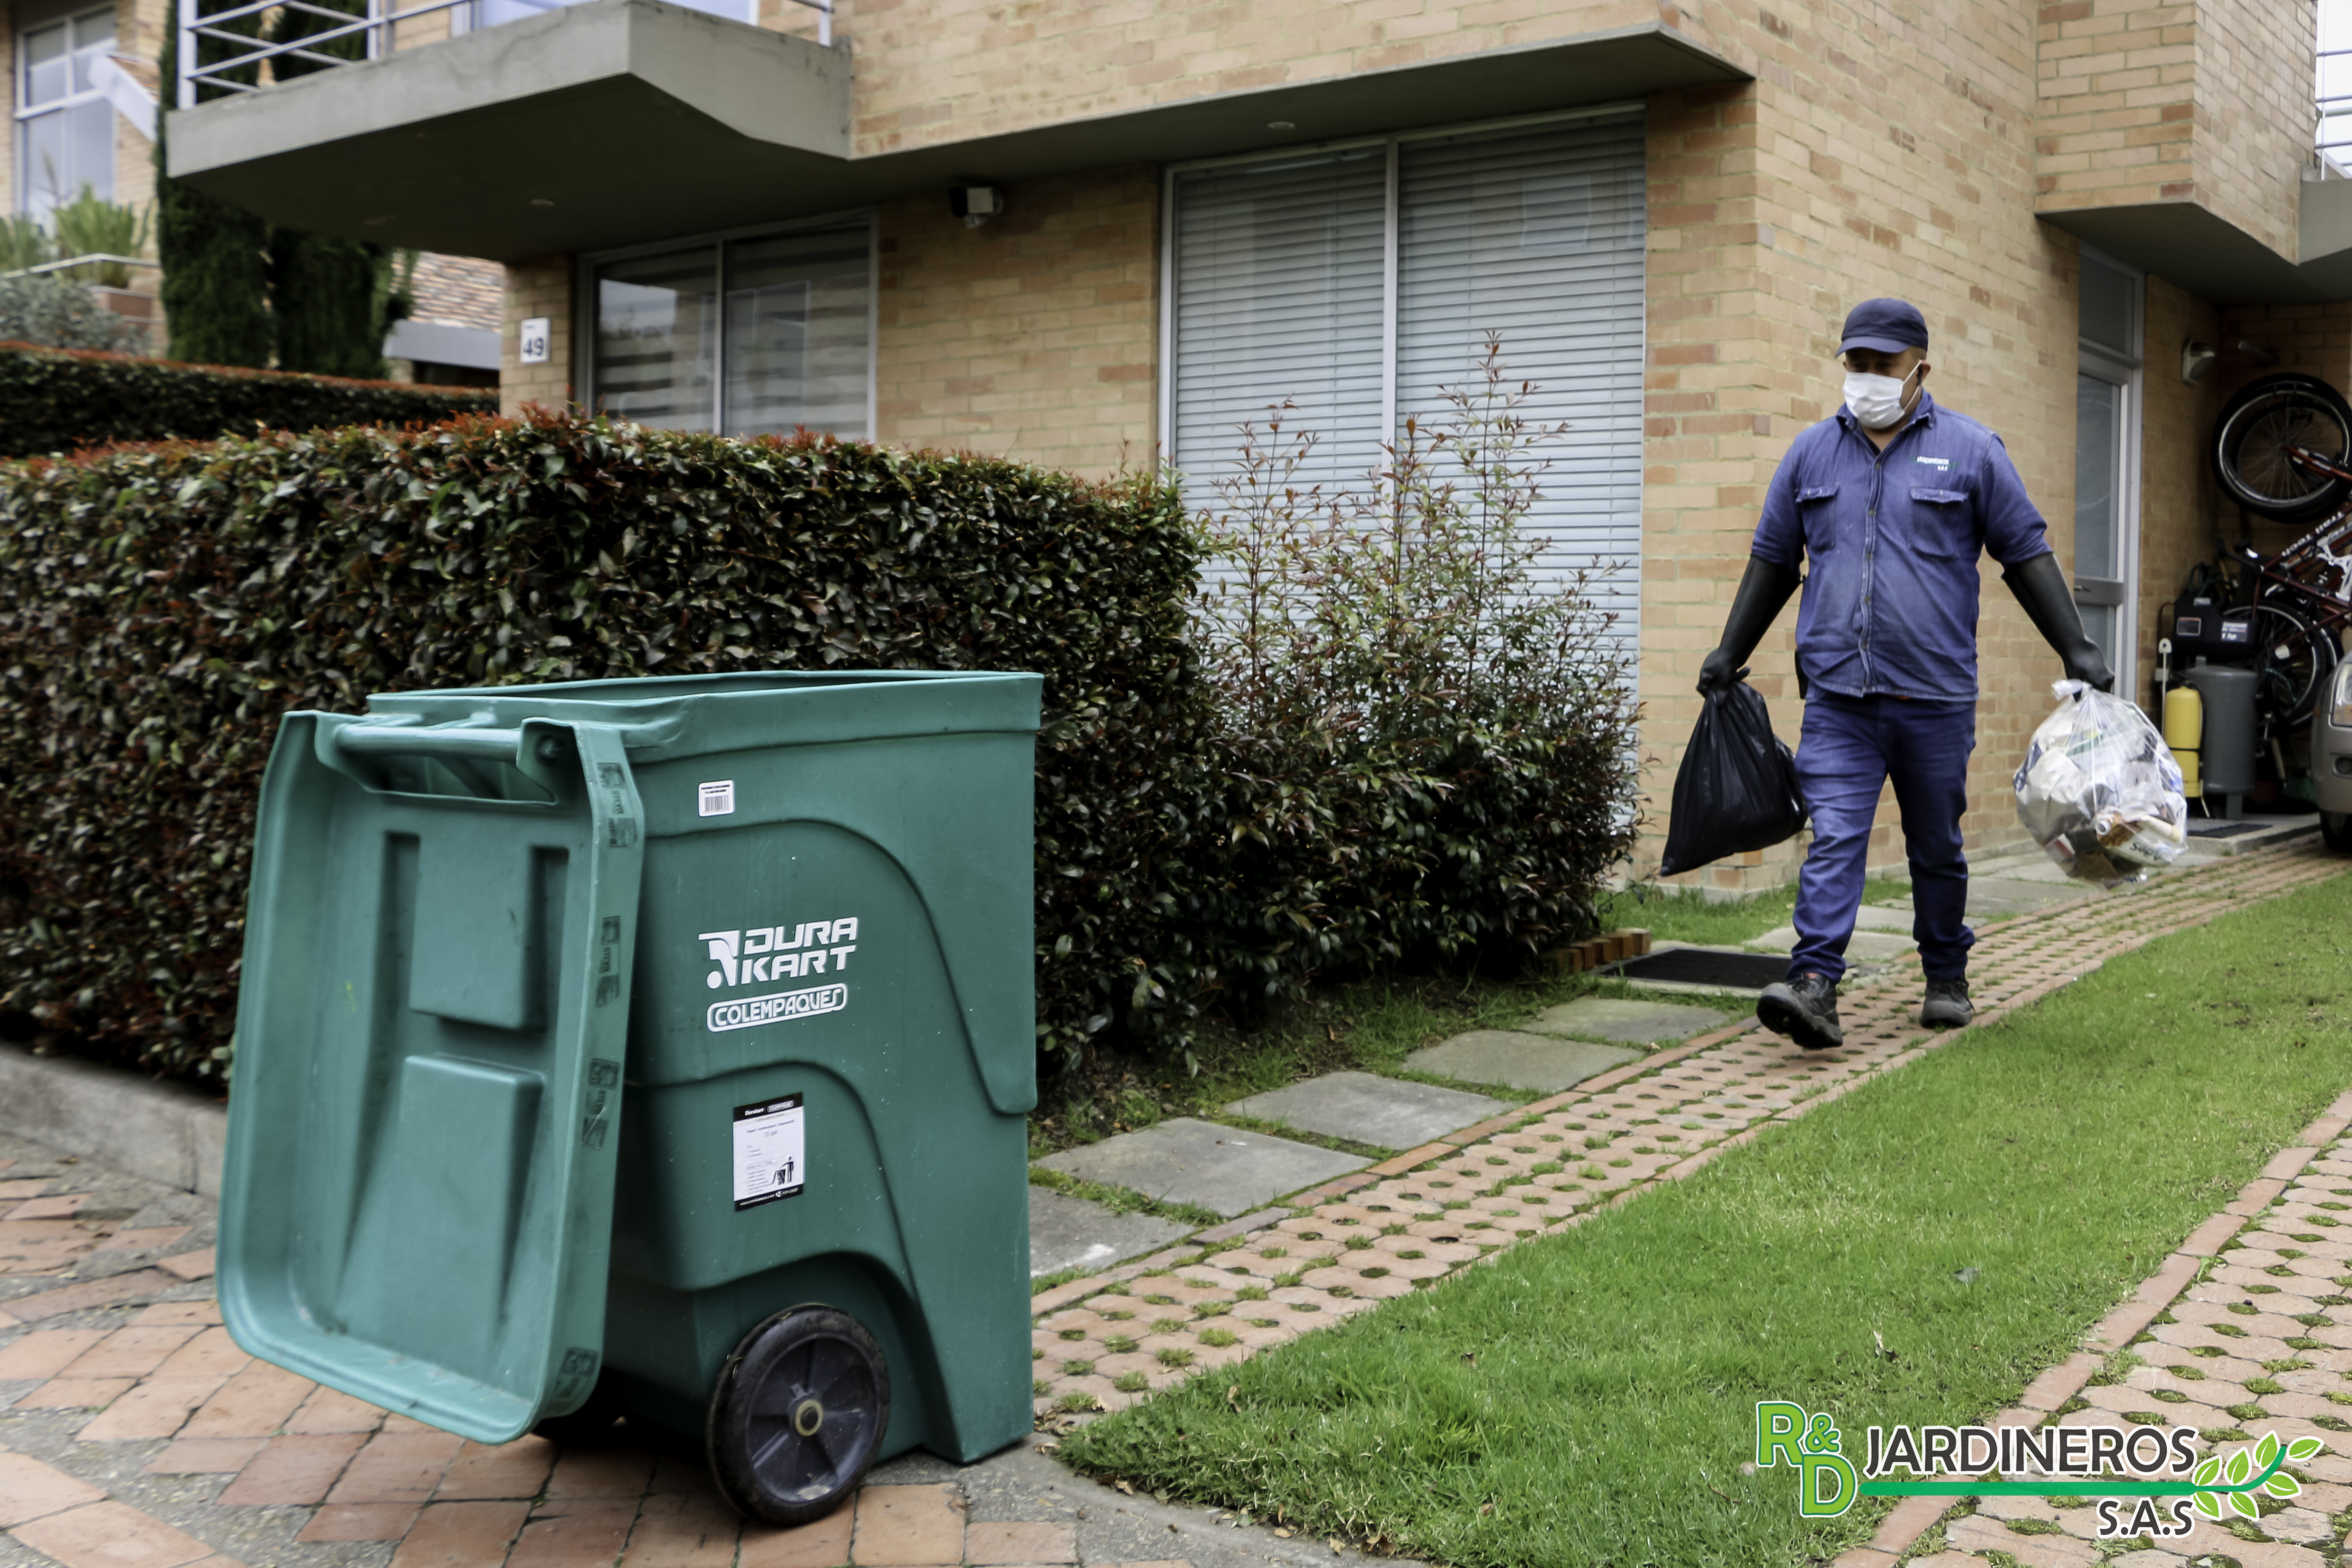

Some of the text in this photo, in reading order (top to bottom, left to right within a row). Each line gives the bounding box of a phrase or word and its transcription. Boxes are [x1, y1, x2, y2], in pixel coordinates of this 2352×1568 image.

[524, 337, 545, 357] 49
[744, 917, 858, 955] DURA
[741, 945, 857, 984] KART
[714, 987, 843, 1027] COLEMPAQUES
[745, 1108, 764, 1116] Durakart
